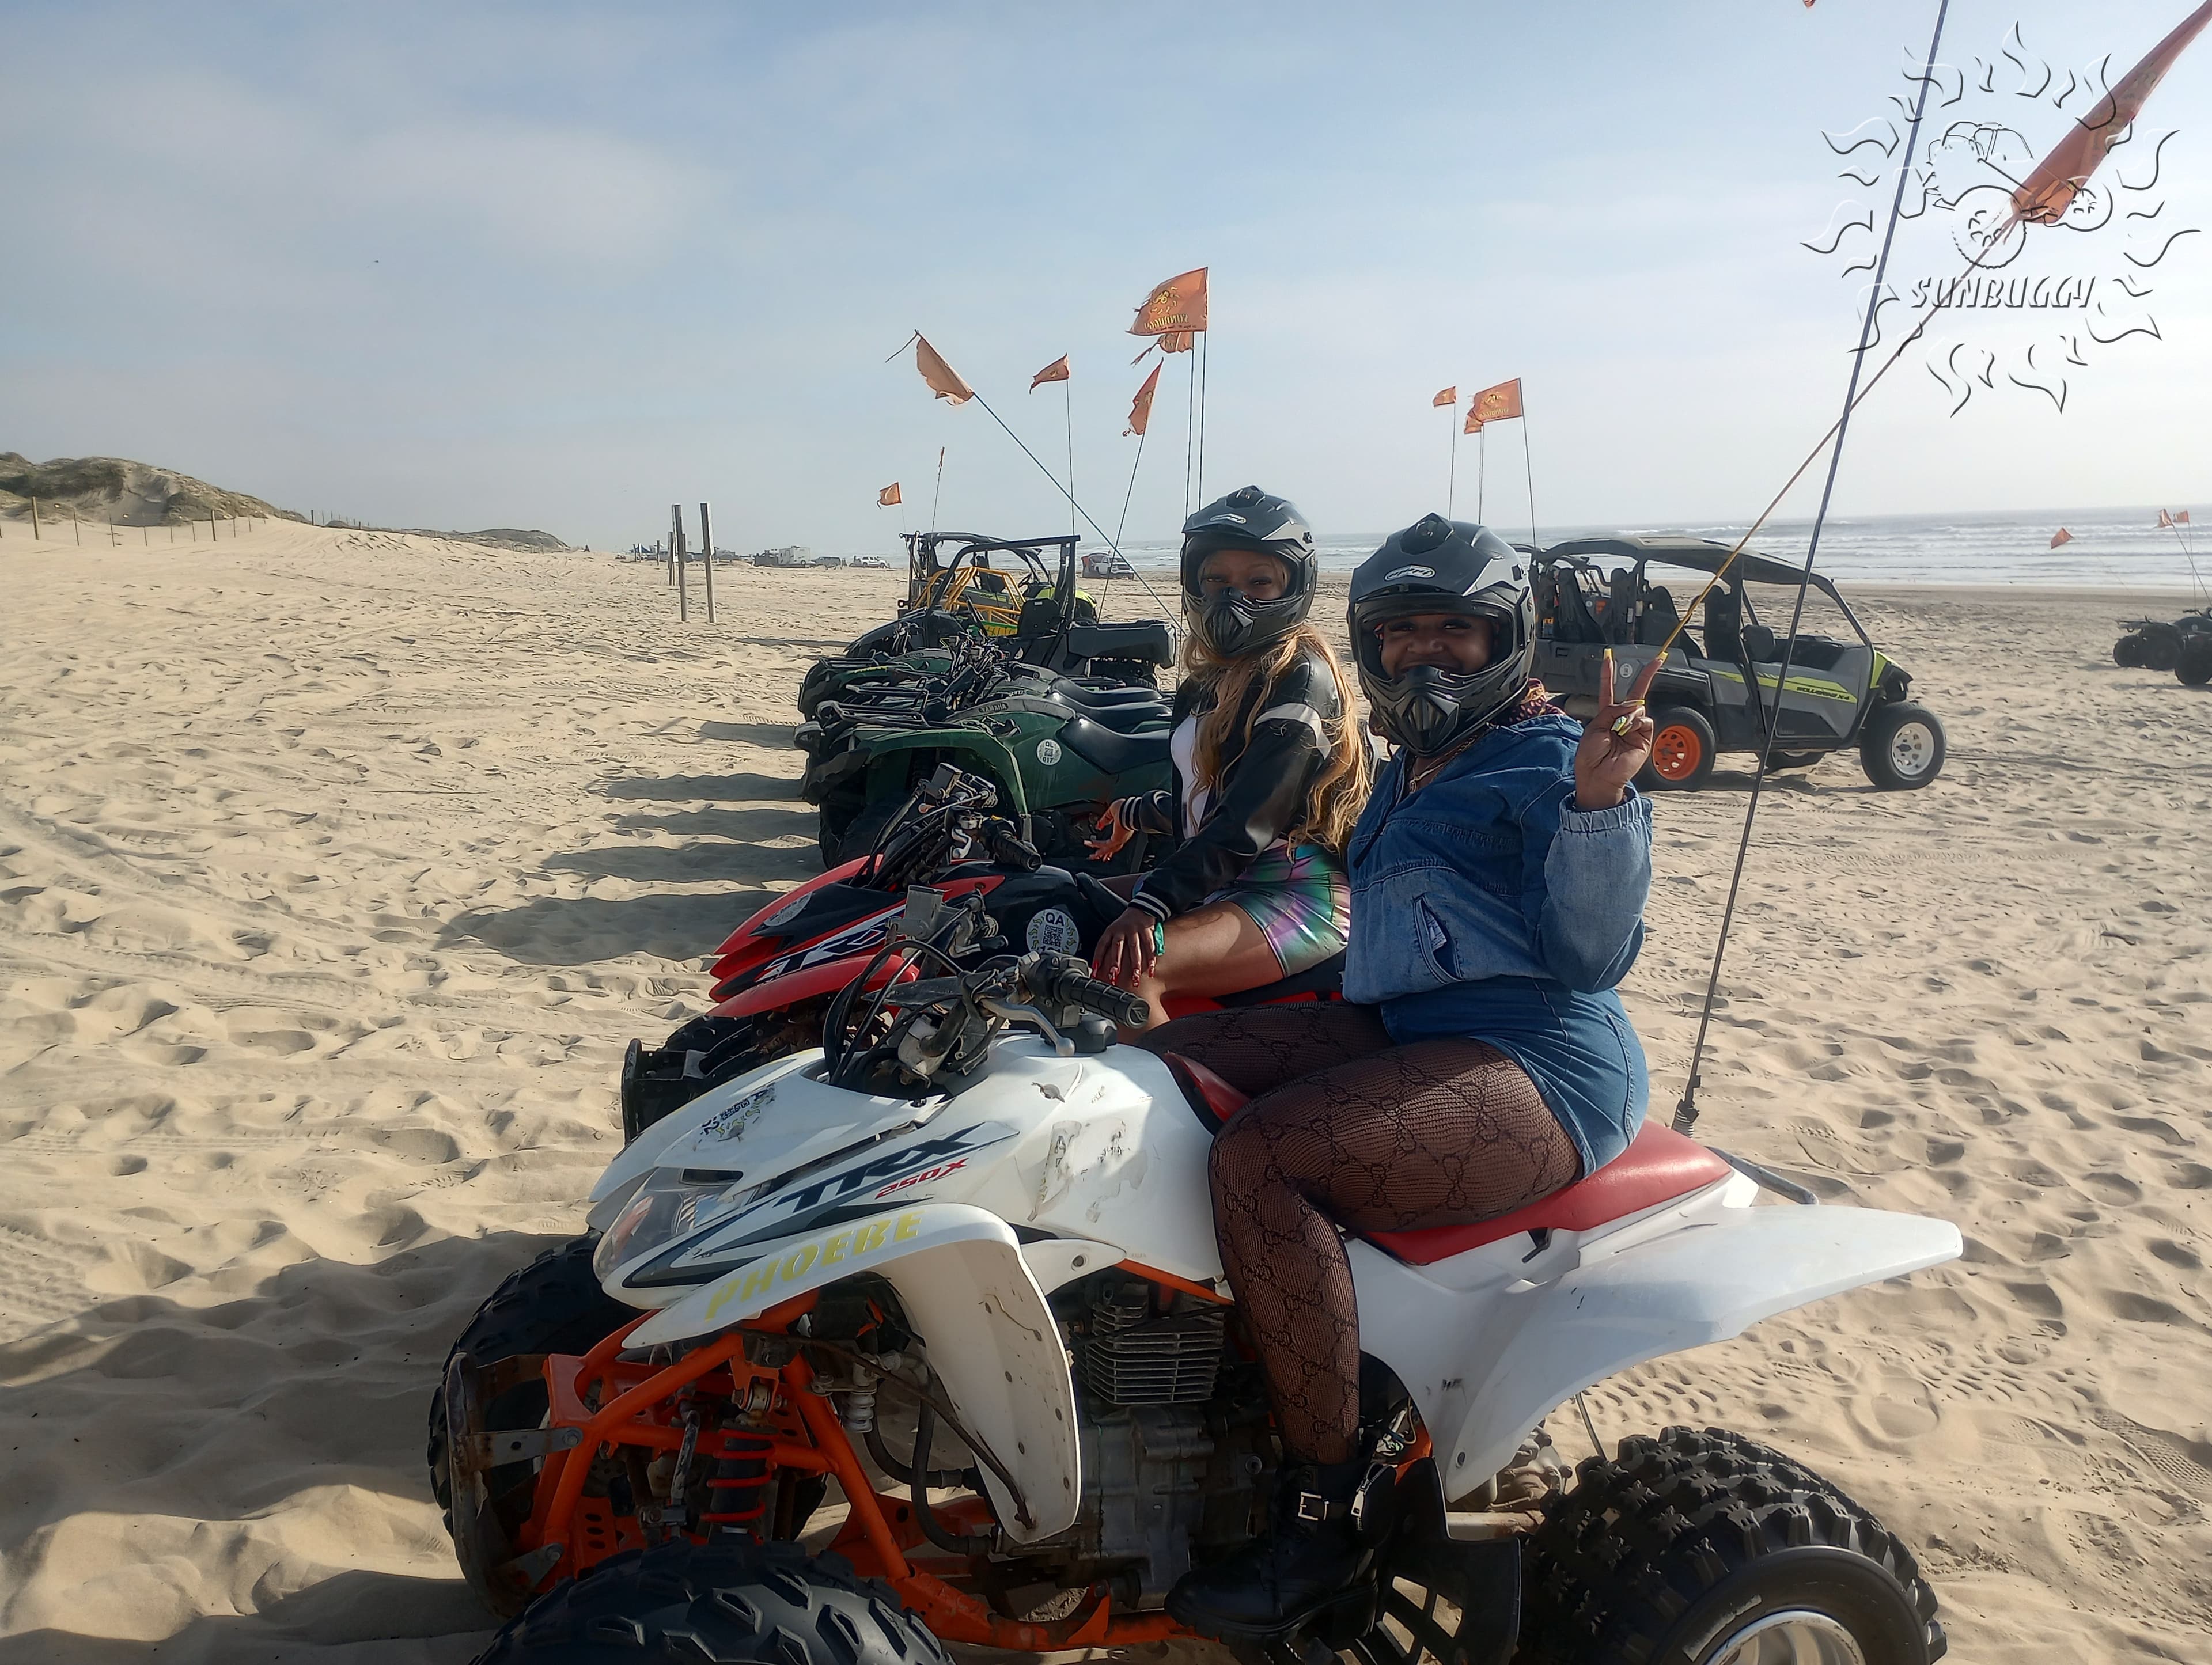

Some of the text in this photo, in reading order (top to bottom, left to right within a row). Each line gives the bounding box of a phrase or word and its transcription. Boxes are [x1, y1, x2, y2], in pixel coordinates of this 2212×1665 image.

[981, 703, 1007, 712] YAMAHA
[1045, 912, 1065, 927] QA
[772, 1122, 986, 1213] TRX
[874, 1157, 969, 1200] 250X
[704, 1210, 925, 1322] PHOEBE
